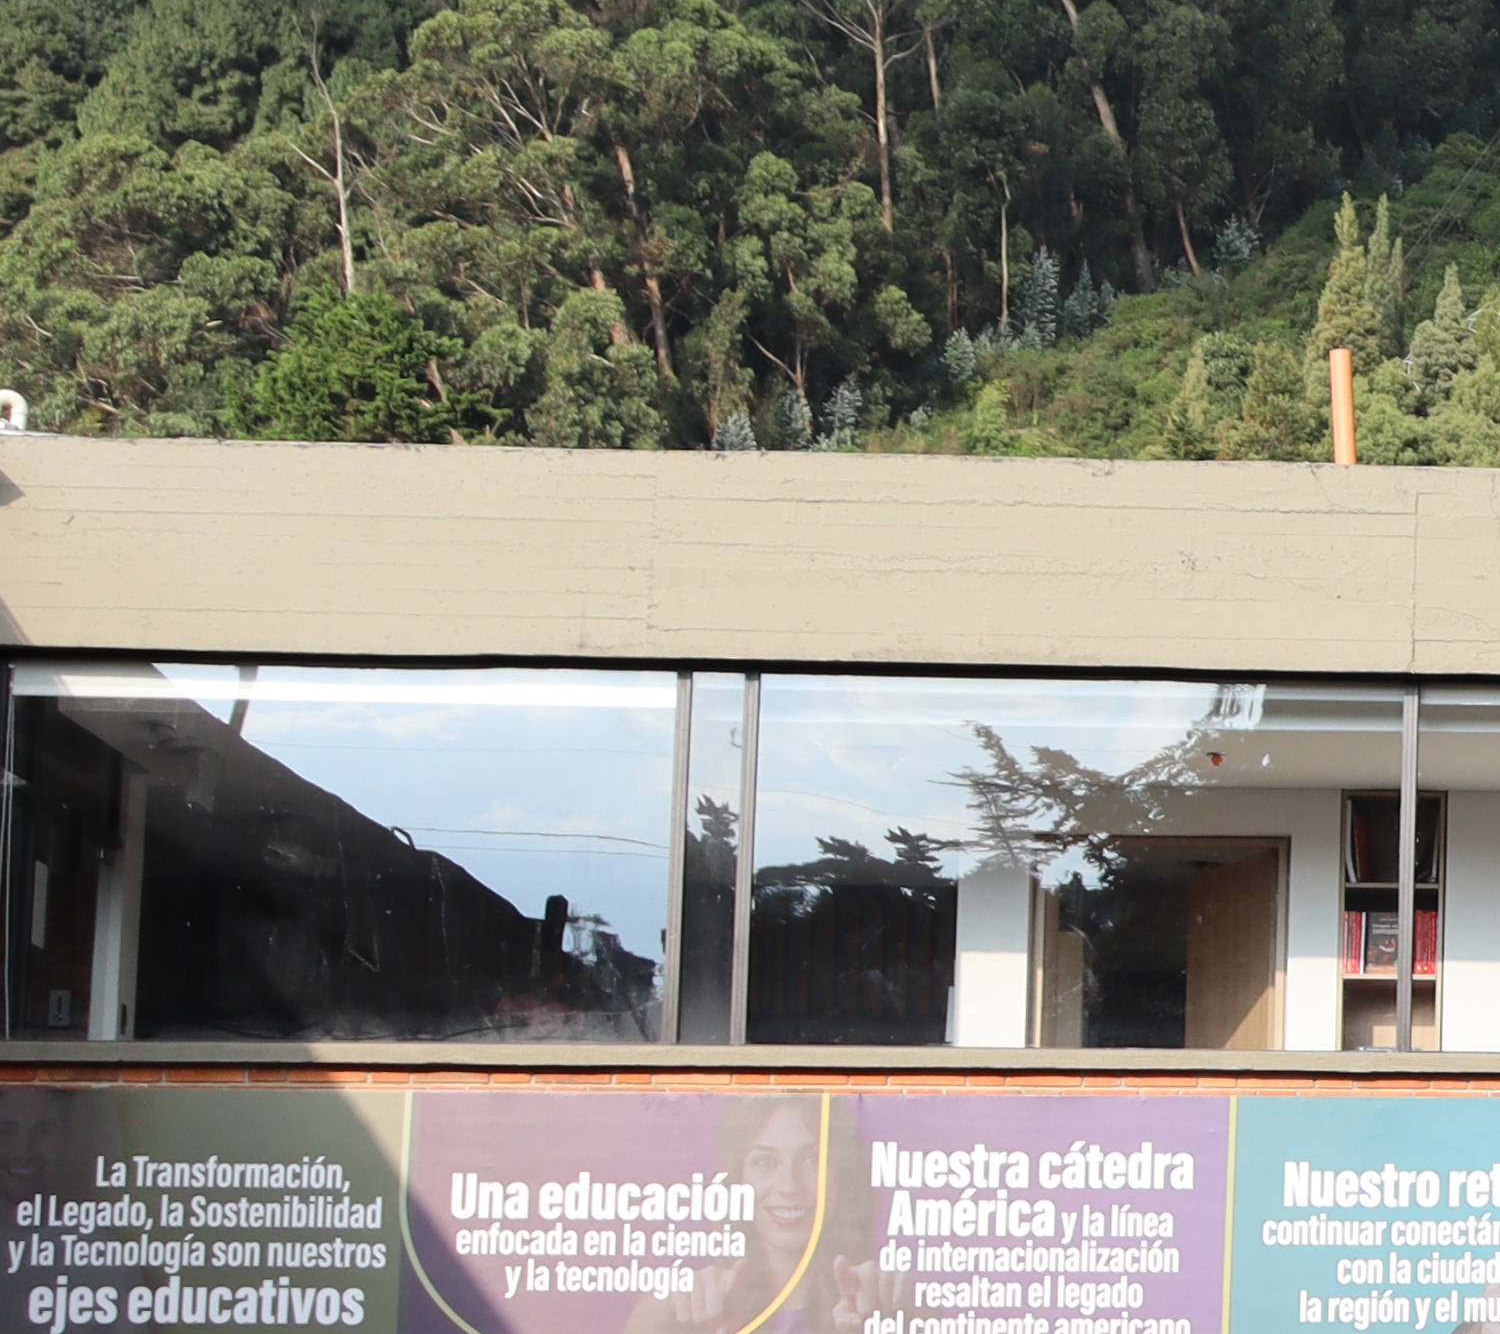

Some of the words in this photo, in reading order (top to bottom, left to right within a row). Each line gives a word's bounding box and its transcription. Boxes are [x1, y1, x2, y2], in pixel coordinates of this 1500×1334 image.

[97, 1156, 126, 1187] La
[133, 1155, 350, 1194] Transformación,
[871, 1142, 1029, 1188] Nuestra
[1039, 1141, 1193, 1189] cátedra
[1284, 1162, 1439, 1207] Nuestro
[17, 1194, 41, 1226] el
[49, 1194, 153, 1234] Legado,
[161, 1195, 183, 1226] la
[190, 1196, 382, 1228] Sostenibilidad
[451, 1173, 529, 1219] Una
[539, 1172, 754, 1221] educación
[888, 1188, 1055, 1237] América
[1062, 1213, 1077, 1244] y
[1083, 1205, 1104, 1237] la
[1111, 1205, 1173, 1237] línea
[457, 1222, 577, 1255] enfocada
[584, 1231, 615, 1255] en
[623, 1224, 645, 1255] la
[652, 1224, 745, 1256] ciencia
[1263, 1214, 1386, 1245] continuar
[8, 1241, 25, 1273] y
[31, 1234, 54, 1265] la
[61, 1233, 205, 1273] Tecnología
[212, 1242, 260, 1266] son
[268, 1238, 386, 1268] nuestros
[880, 1239, 911, 1271] de
[918, 1240, 1179, 1272] internacionalización
[1338, 1260, 1382, 1283] con
[1390, 1252, 1411, 1283] la
[505, 1266, 521, 1298] y
[527, 1259, 549, 1291] la
[556, 1259, 694, 1300] tecnología
[915, 1275, 1021, 1307] resaltan
[1028, 1276, 1051, 1307] el
[1058, 1276, 1143, 1315] legado
[29, 1276, 117, 1334] ejes
[128, 1276, 364, 1325] educativos
[1300, 1290, 1321, 1322] la
[1328, 1290, 1409, 1330] región
[1415, 1298, 1431, 1329] y
[1436, 1290, 1458, 1322] el
